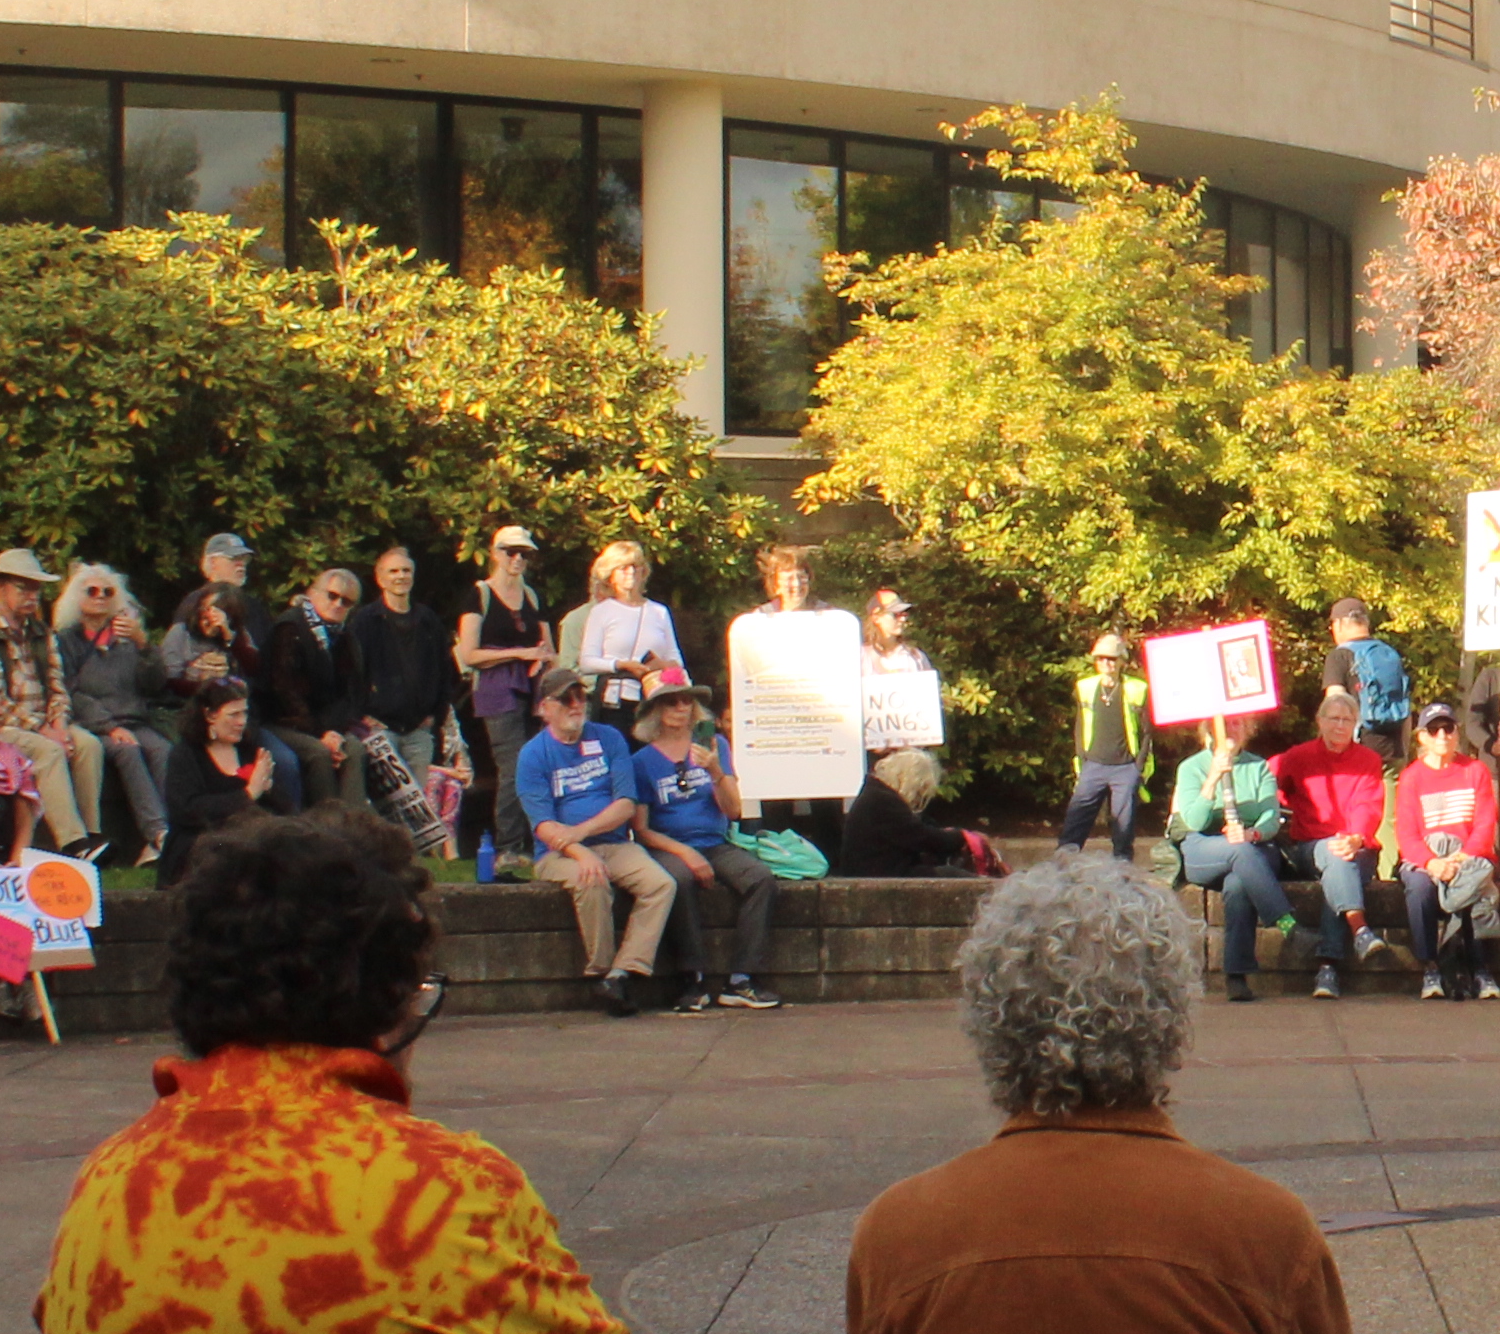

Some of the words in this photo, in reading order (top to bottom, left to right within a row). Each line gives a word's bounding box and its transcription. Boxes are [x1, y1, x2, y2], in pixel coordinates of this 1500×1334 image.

[869, 692, 905, 710] NO
[863, 712, 930, 732] KINGS
[34, 918, 84, 944] BLUE
